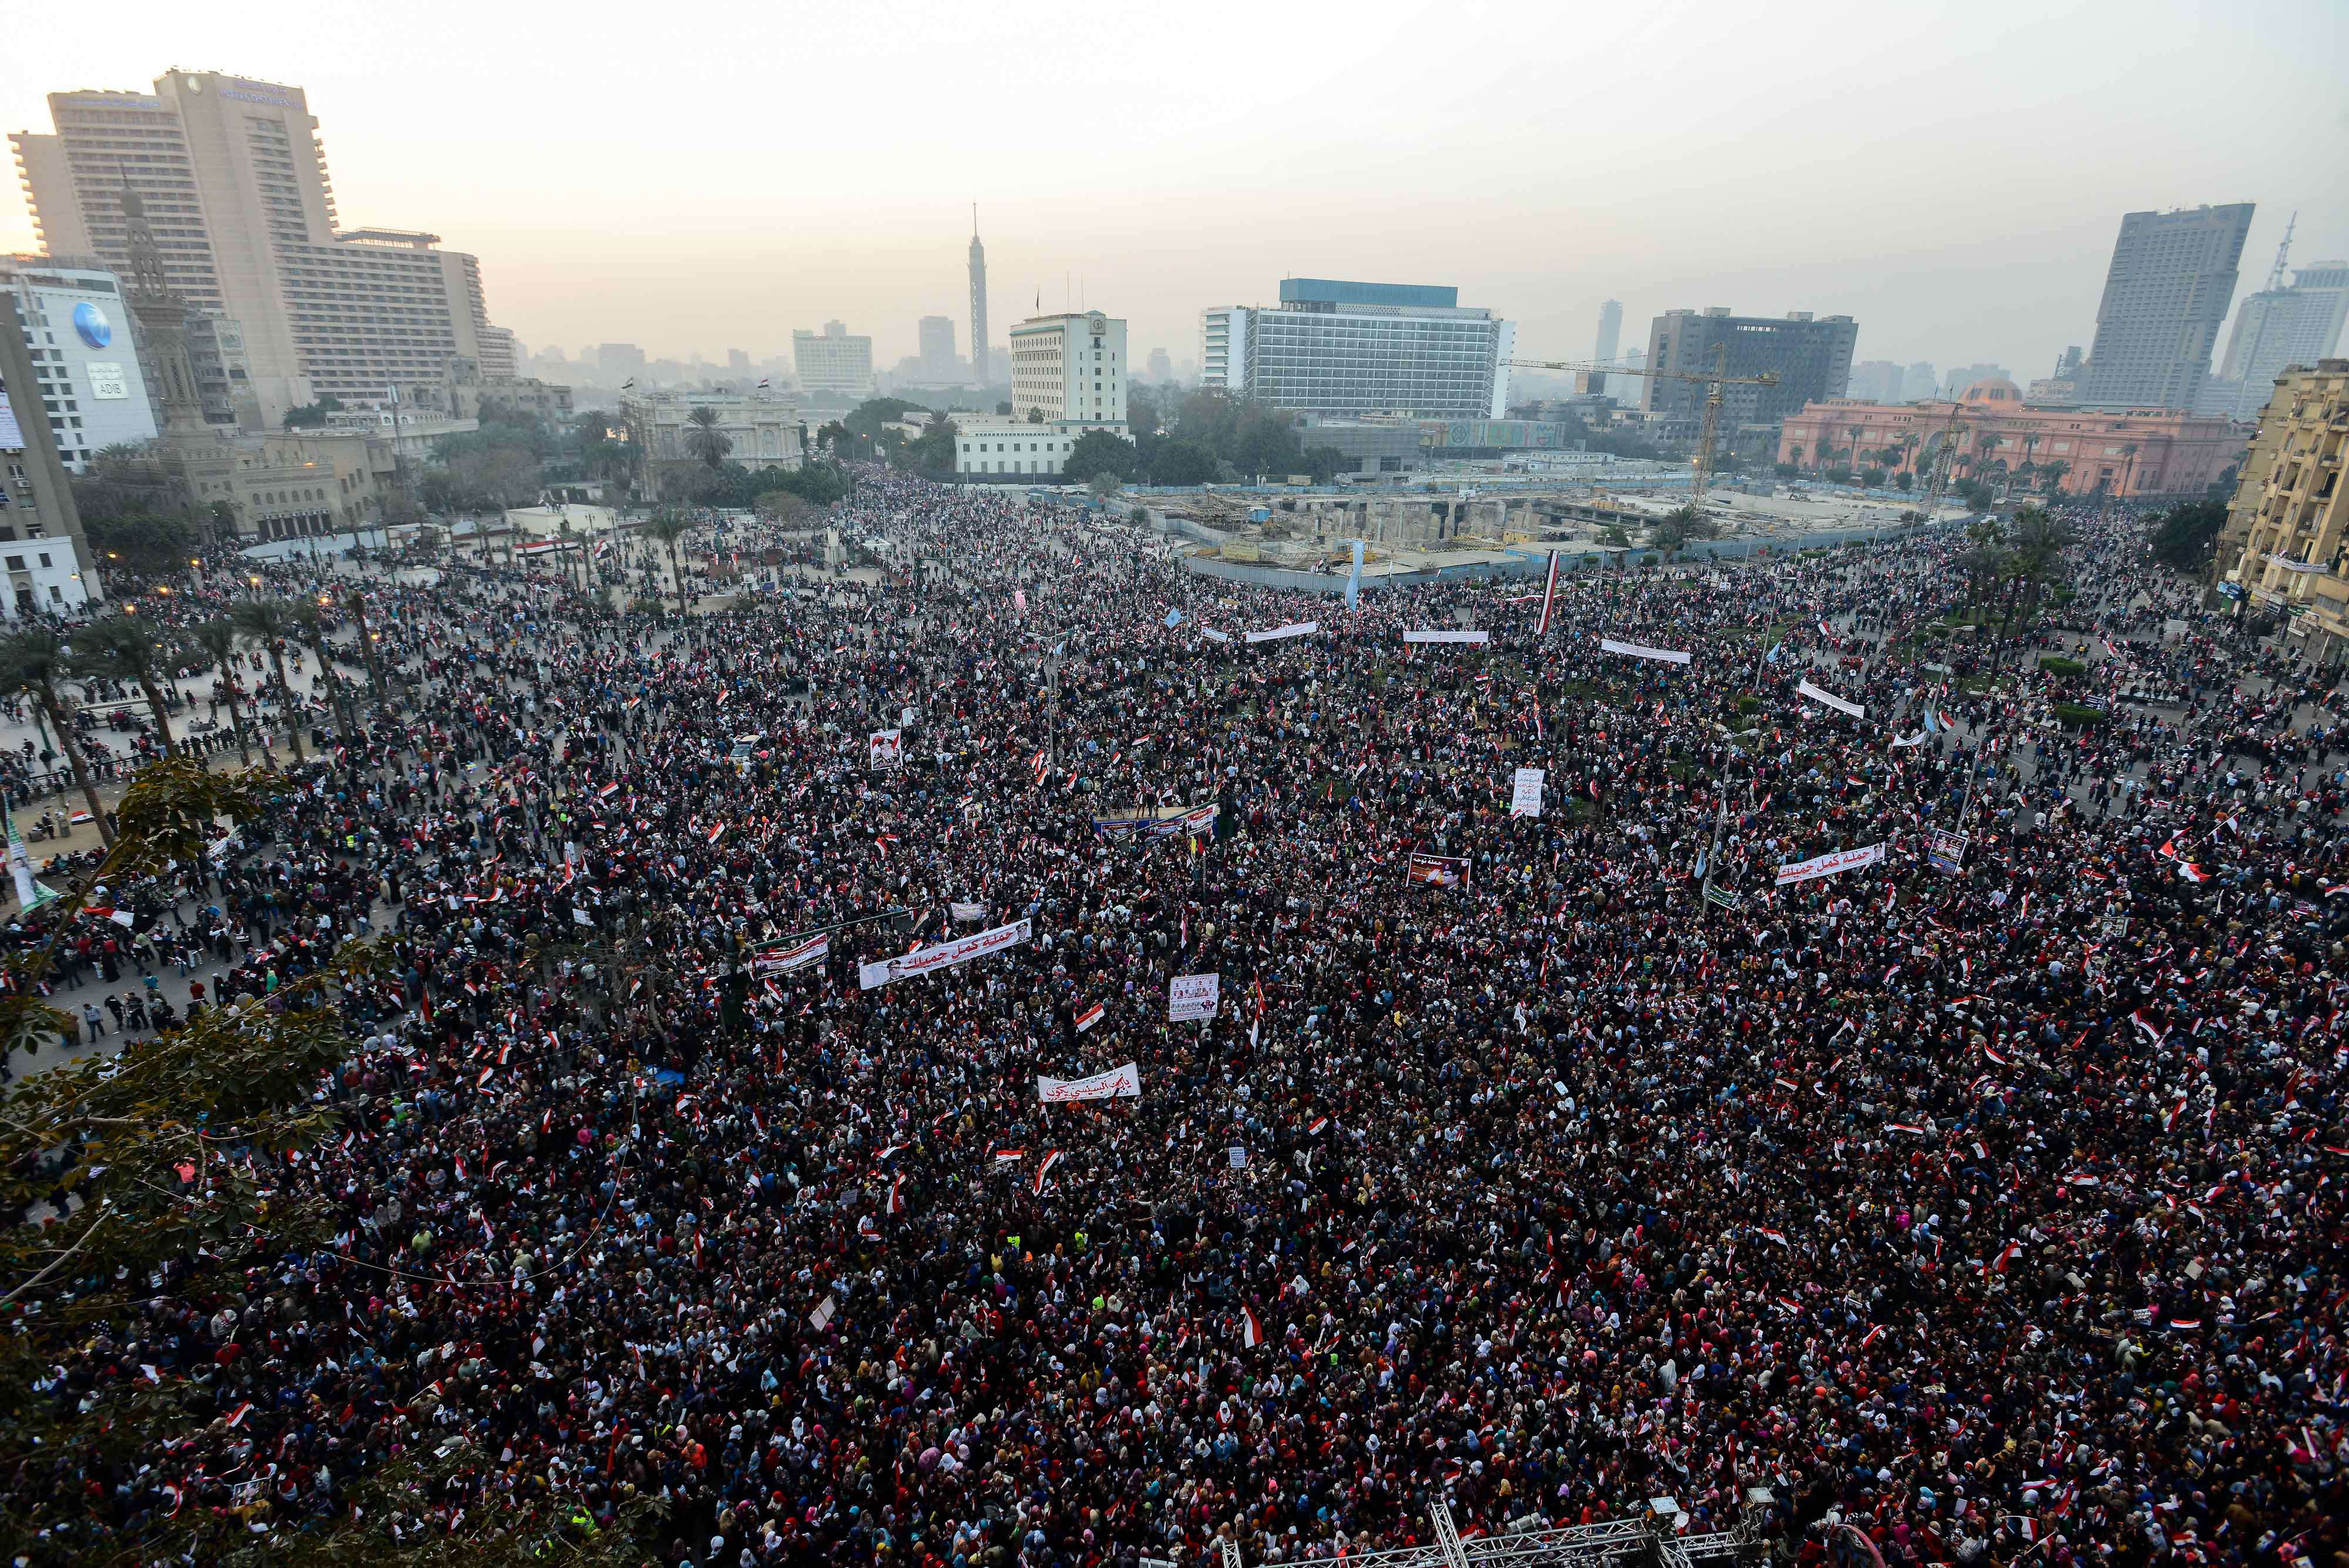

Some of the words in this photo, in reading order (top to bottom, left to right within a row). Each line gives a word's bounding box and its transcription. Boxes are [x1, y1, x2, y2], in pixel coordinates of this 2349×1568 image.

[100, 384, 122, 393] ADIB
[1817, 855, 1839, 873] كمل
[1840, 850, 1870, 863] حملة
[1778, 864, 1814, 879] جميلك
[982, 931, 1014, 947] حملة
[951, 940, 978, 959] كمل
[904, 951, 947, 970] جميلك
